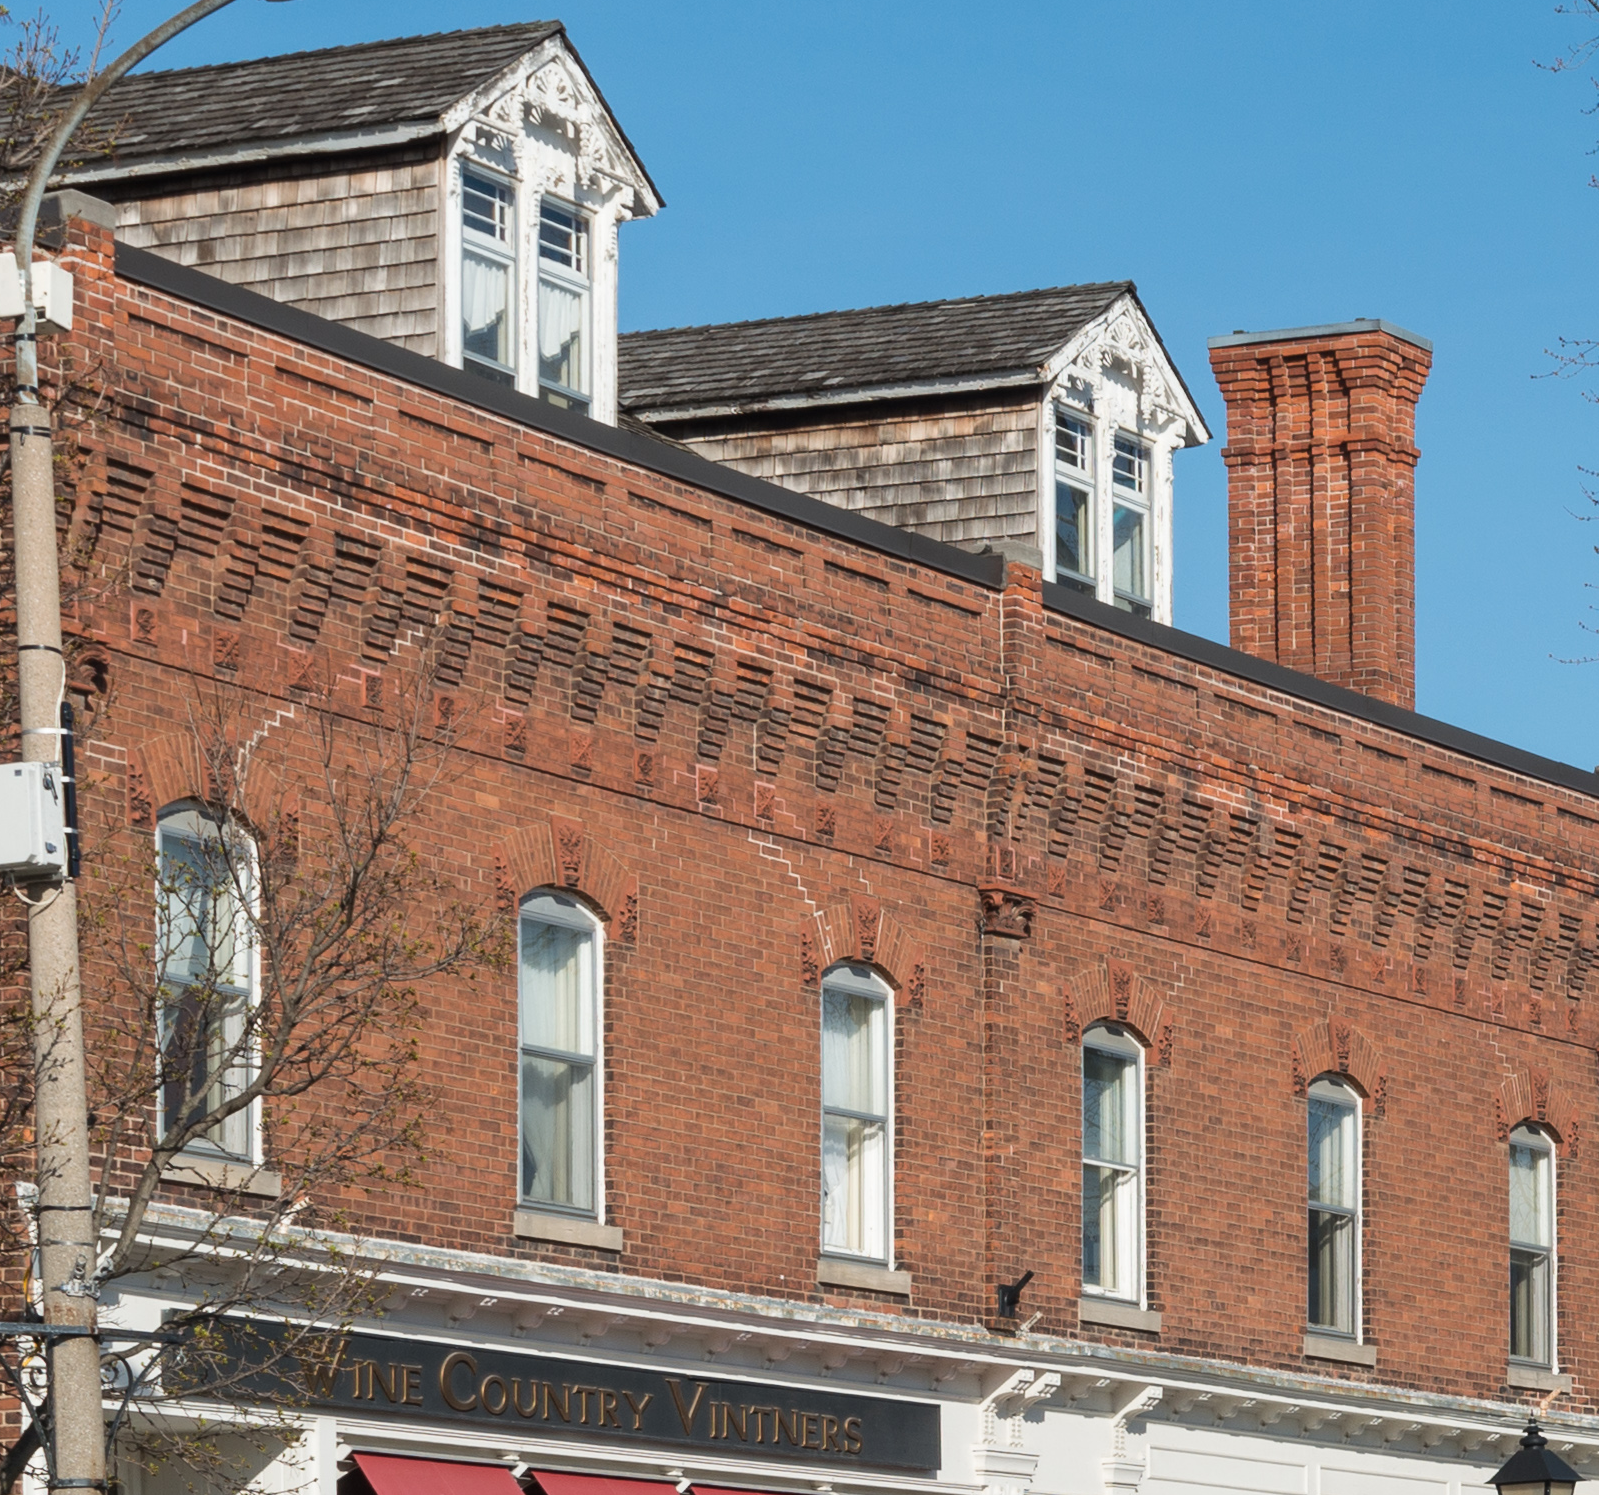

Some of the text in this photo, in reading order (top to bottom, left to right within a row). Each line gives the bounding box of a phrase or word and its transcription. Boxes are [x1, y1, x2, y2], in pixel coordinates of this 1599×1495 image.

[300, 1336, 864, 1455] WINE COUNTRY VINTNERS
